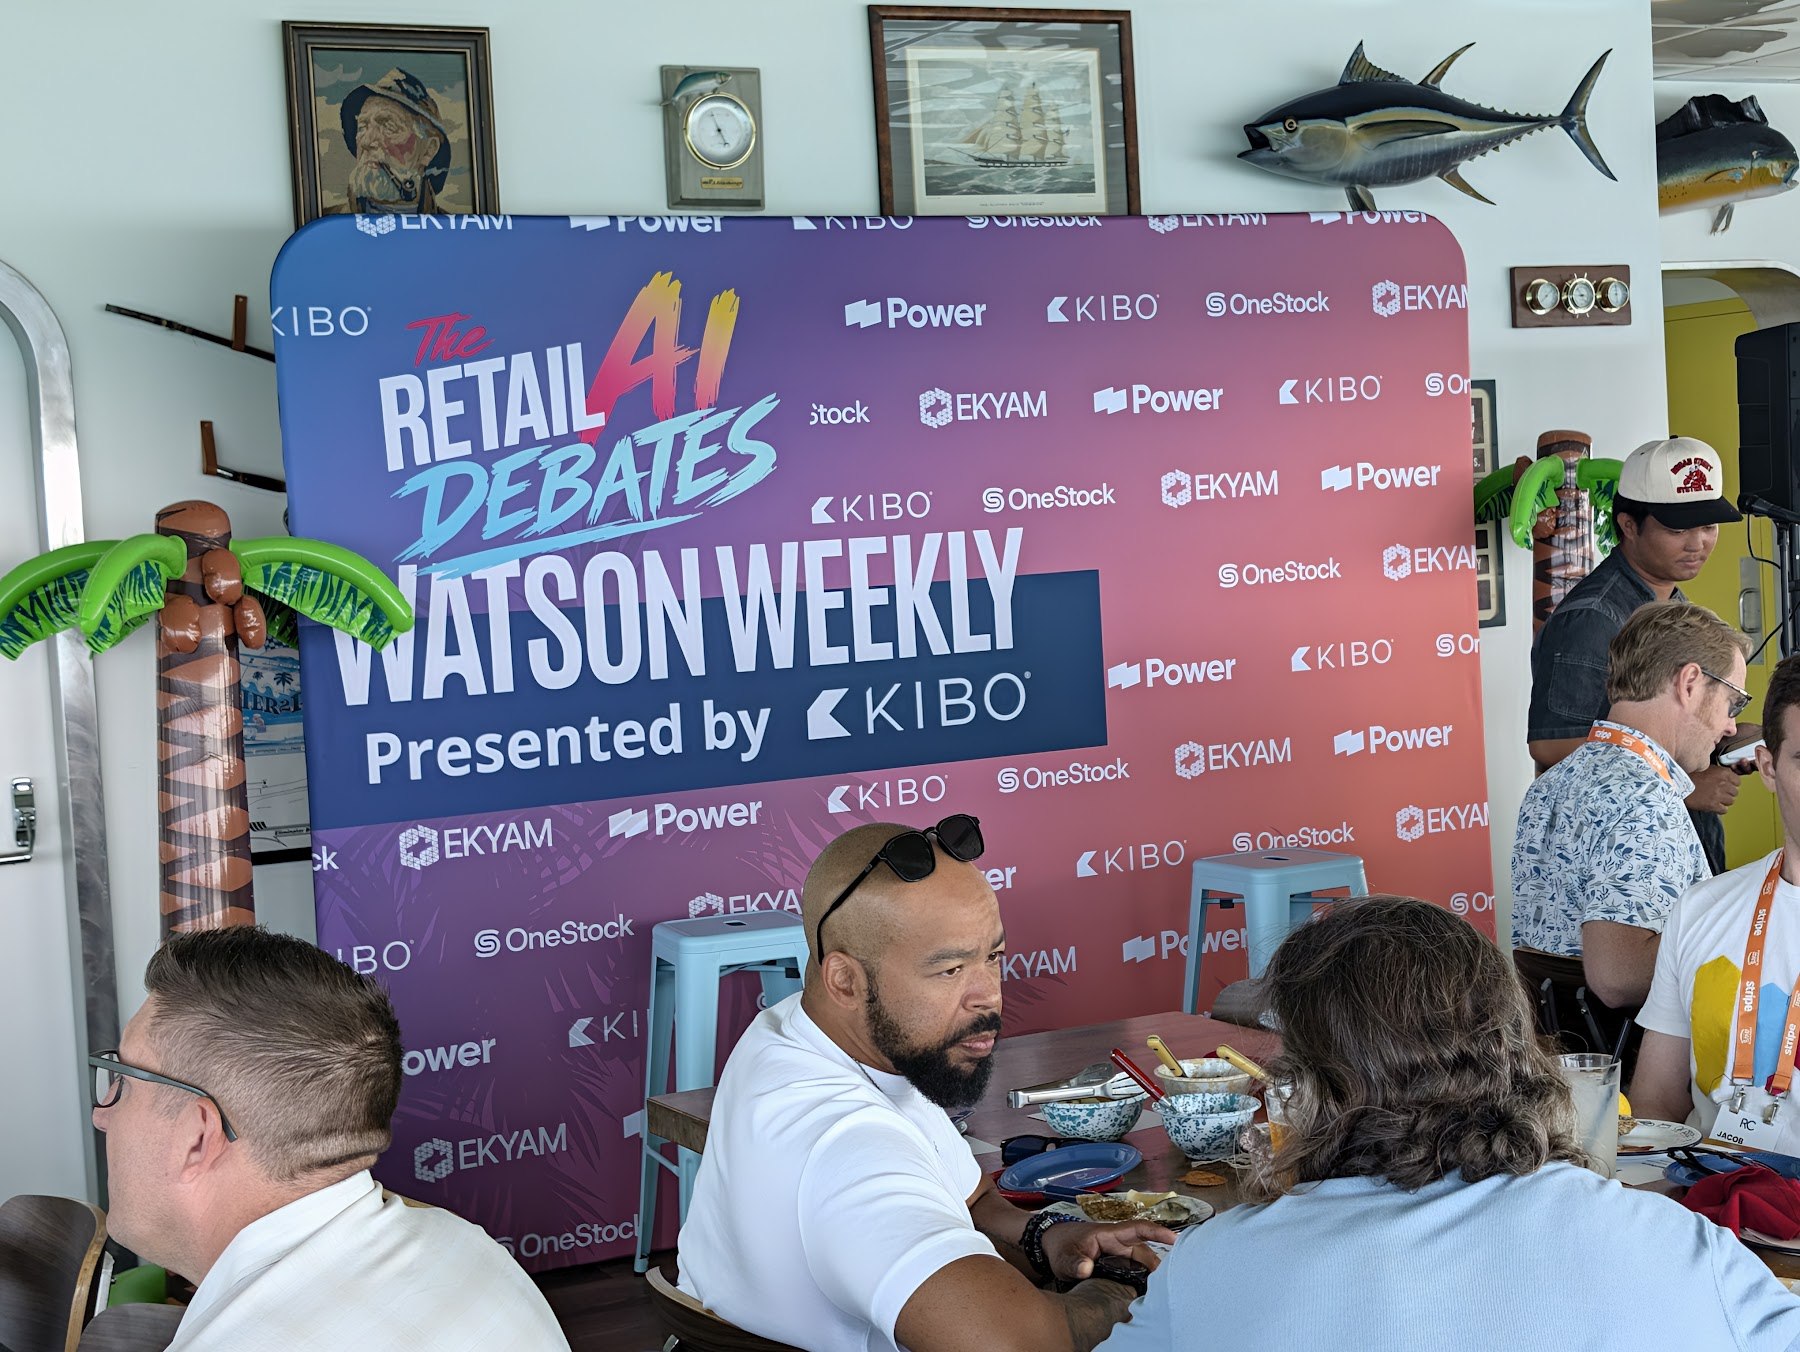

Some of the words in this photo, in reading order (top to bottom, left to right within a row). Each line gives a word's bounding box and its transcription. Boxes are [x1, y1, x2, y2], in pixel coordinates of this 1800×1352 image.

[887, 298, 986, 328] Power
[1076, 294, 1157, 321] KIBO
[1230, 291, 1329, 314] OneStock
[406, 312, 495, 367] The
[379, 342, 605, 472] RETAIL
[579, 271, 740, 446] AI
[1133, 385, 1223, 413] Power
[1306, 376, 1381, 404] KIBO
[957, 391, 1047, 420] EKYAM
[390, 393, 781, 562] DEBATES
[1196, 470, 1278, 499] EKYAM
[1357, 463, 1440, 490] Power
[843, 491, 931, 522] KIBO
[1009, 483, 1115, 510] OneStock
[1243, 558, 1341, 584] OneStock
[333, 548, 706, 706] WATSON
[715, 527, 1024, 673] WEEKLY
[1318, 639, 1392, 669] KIBO
[1146, 659, 1236, 687] Power
[366, 703, 683, 785] Presented
[703, 699, 771, 761] by
[866, 673, 1027, 734] KIBO
[1370, 725, 1452, 753] Power
[1209, 737, 1291, 770] EKYAM
[1024, 758, 1129, 788] OneStock
[859, 775, 946, 809] KIBO
[655, 801, 762, 835] Power
[444, 819, 552, 858] EKYAM
[1257, 821, 1354, 851] OneStock
[1105, 841, 1185, 873] KIBO
[729, 889, 802, 914] EKYA
[506, 914, 634, 951] OneStock
[1753, 908, 1767, 936] stripe
[1001, 946, 1077, 981] KYAM
[1743, 980, 1756, 1012] stripe
[1784, 1023, 1797, 1056] stripe
[402, 1038, 496, 1076] ower
[459, 1123, 566, 1169] EKYAM
[1716, 1130, 1744, 1145] JACOB
